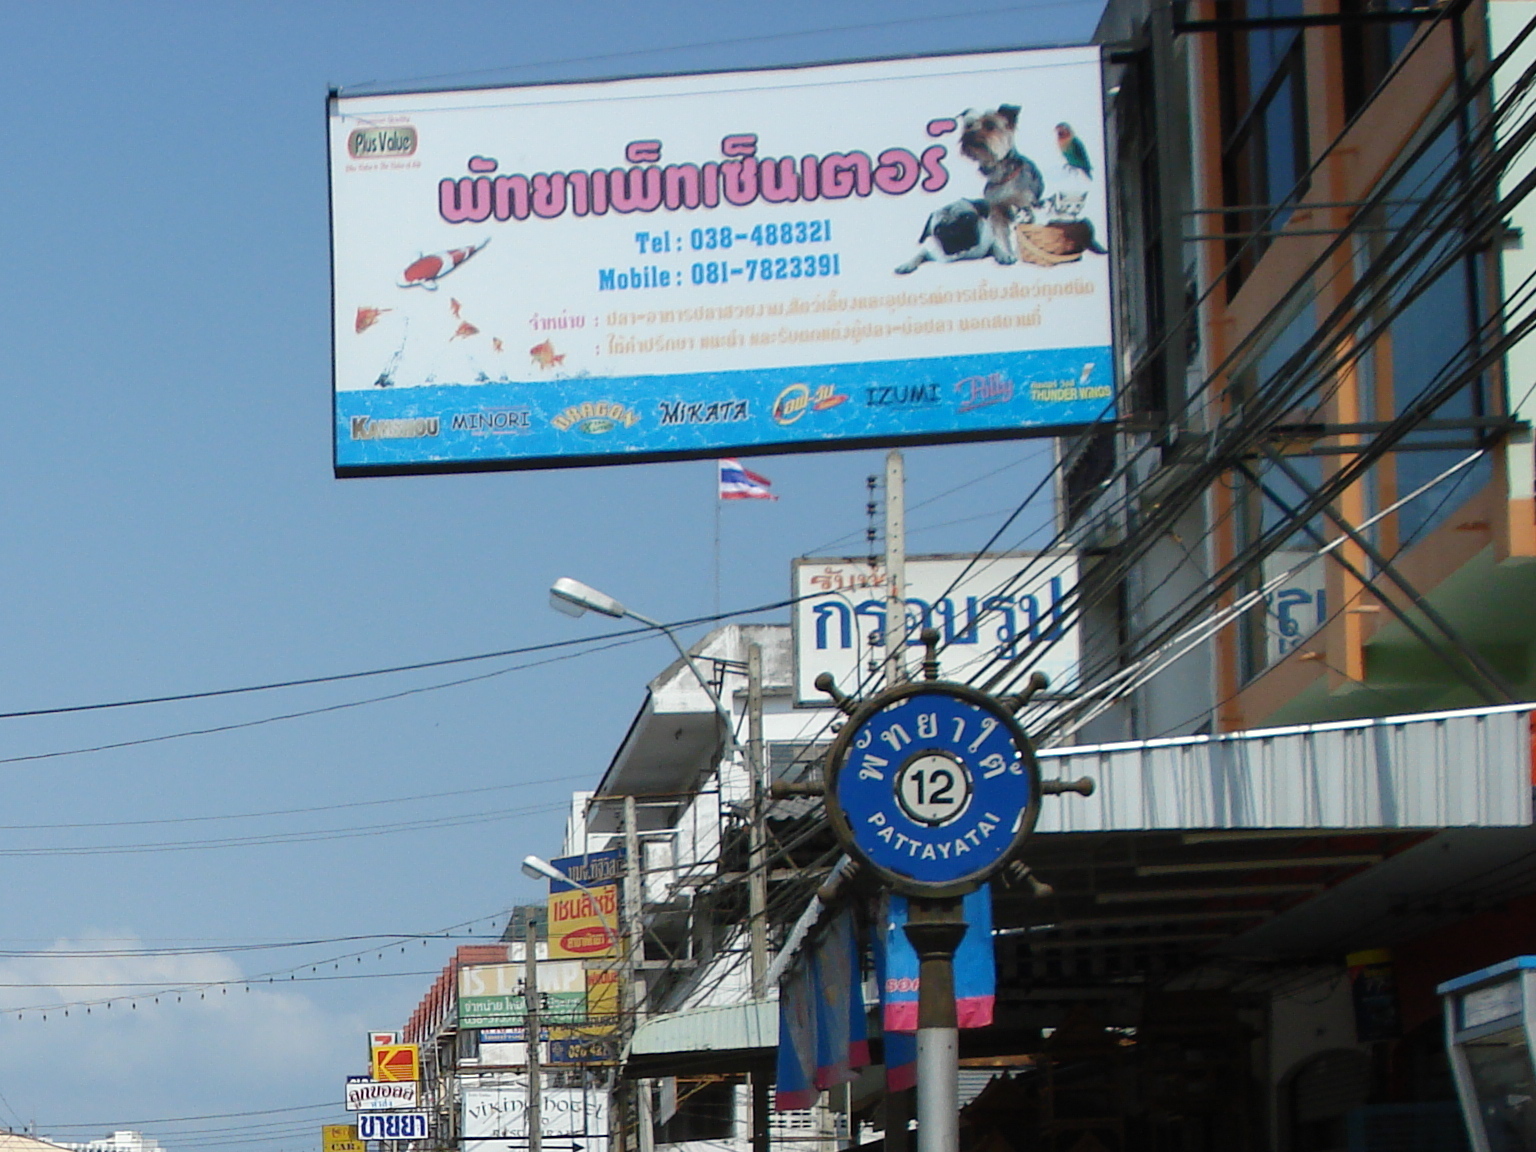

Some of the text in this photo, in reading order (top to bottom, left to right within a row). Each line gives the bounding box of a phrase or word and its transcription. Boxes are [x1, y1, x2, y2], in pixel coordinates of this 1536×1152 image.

[355, 131, 411, 154] Plus Value
[438, 117, 958, 225] พัทยาเพ็ทเซ็นเตอร์
[690, 219, 832, 251] 038-488321
[690, 253, 841, 286] 081-7823391
[866, 382, 941, 406] IZUMI
[1030, 387, 1078, 401] THUNDER
[452, 411, 531, 430] MINORI
[550, 400, 642, 432] DRAGON
[856, 710, 1024, 783] พัทยาใต้
[910, 768, 955, 806] 12
[867, 811, 1002, 861] PATTAYATAI
[360, 1115, 426, 1138] ขายยา
